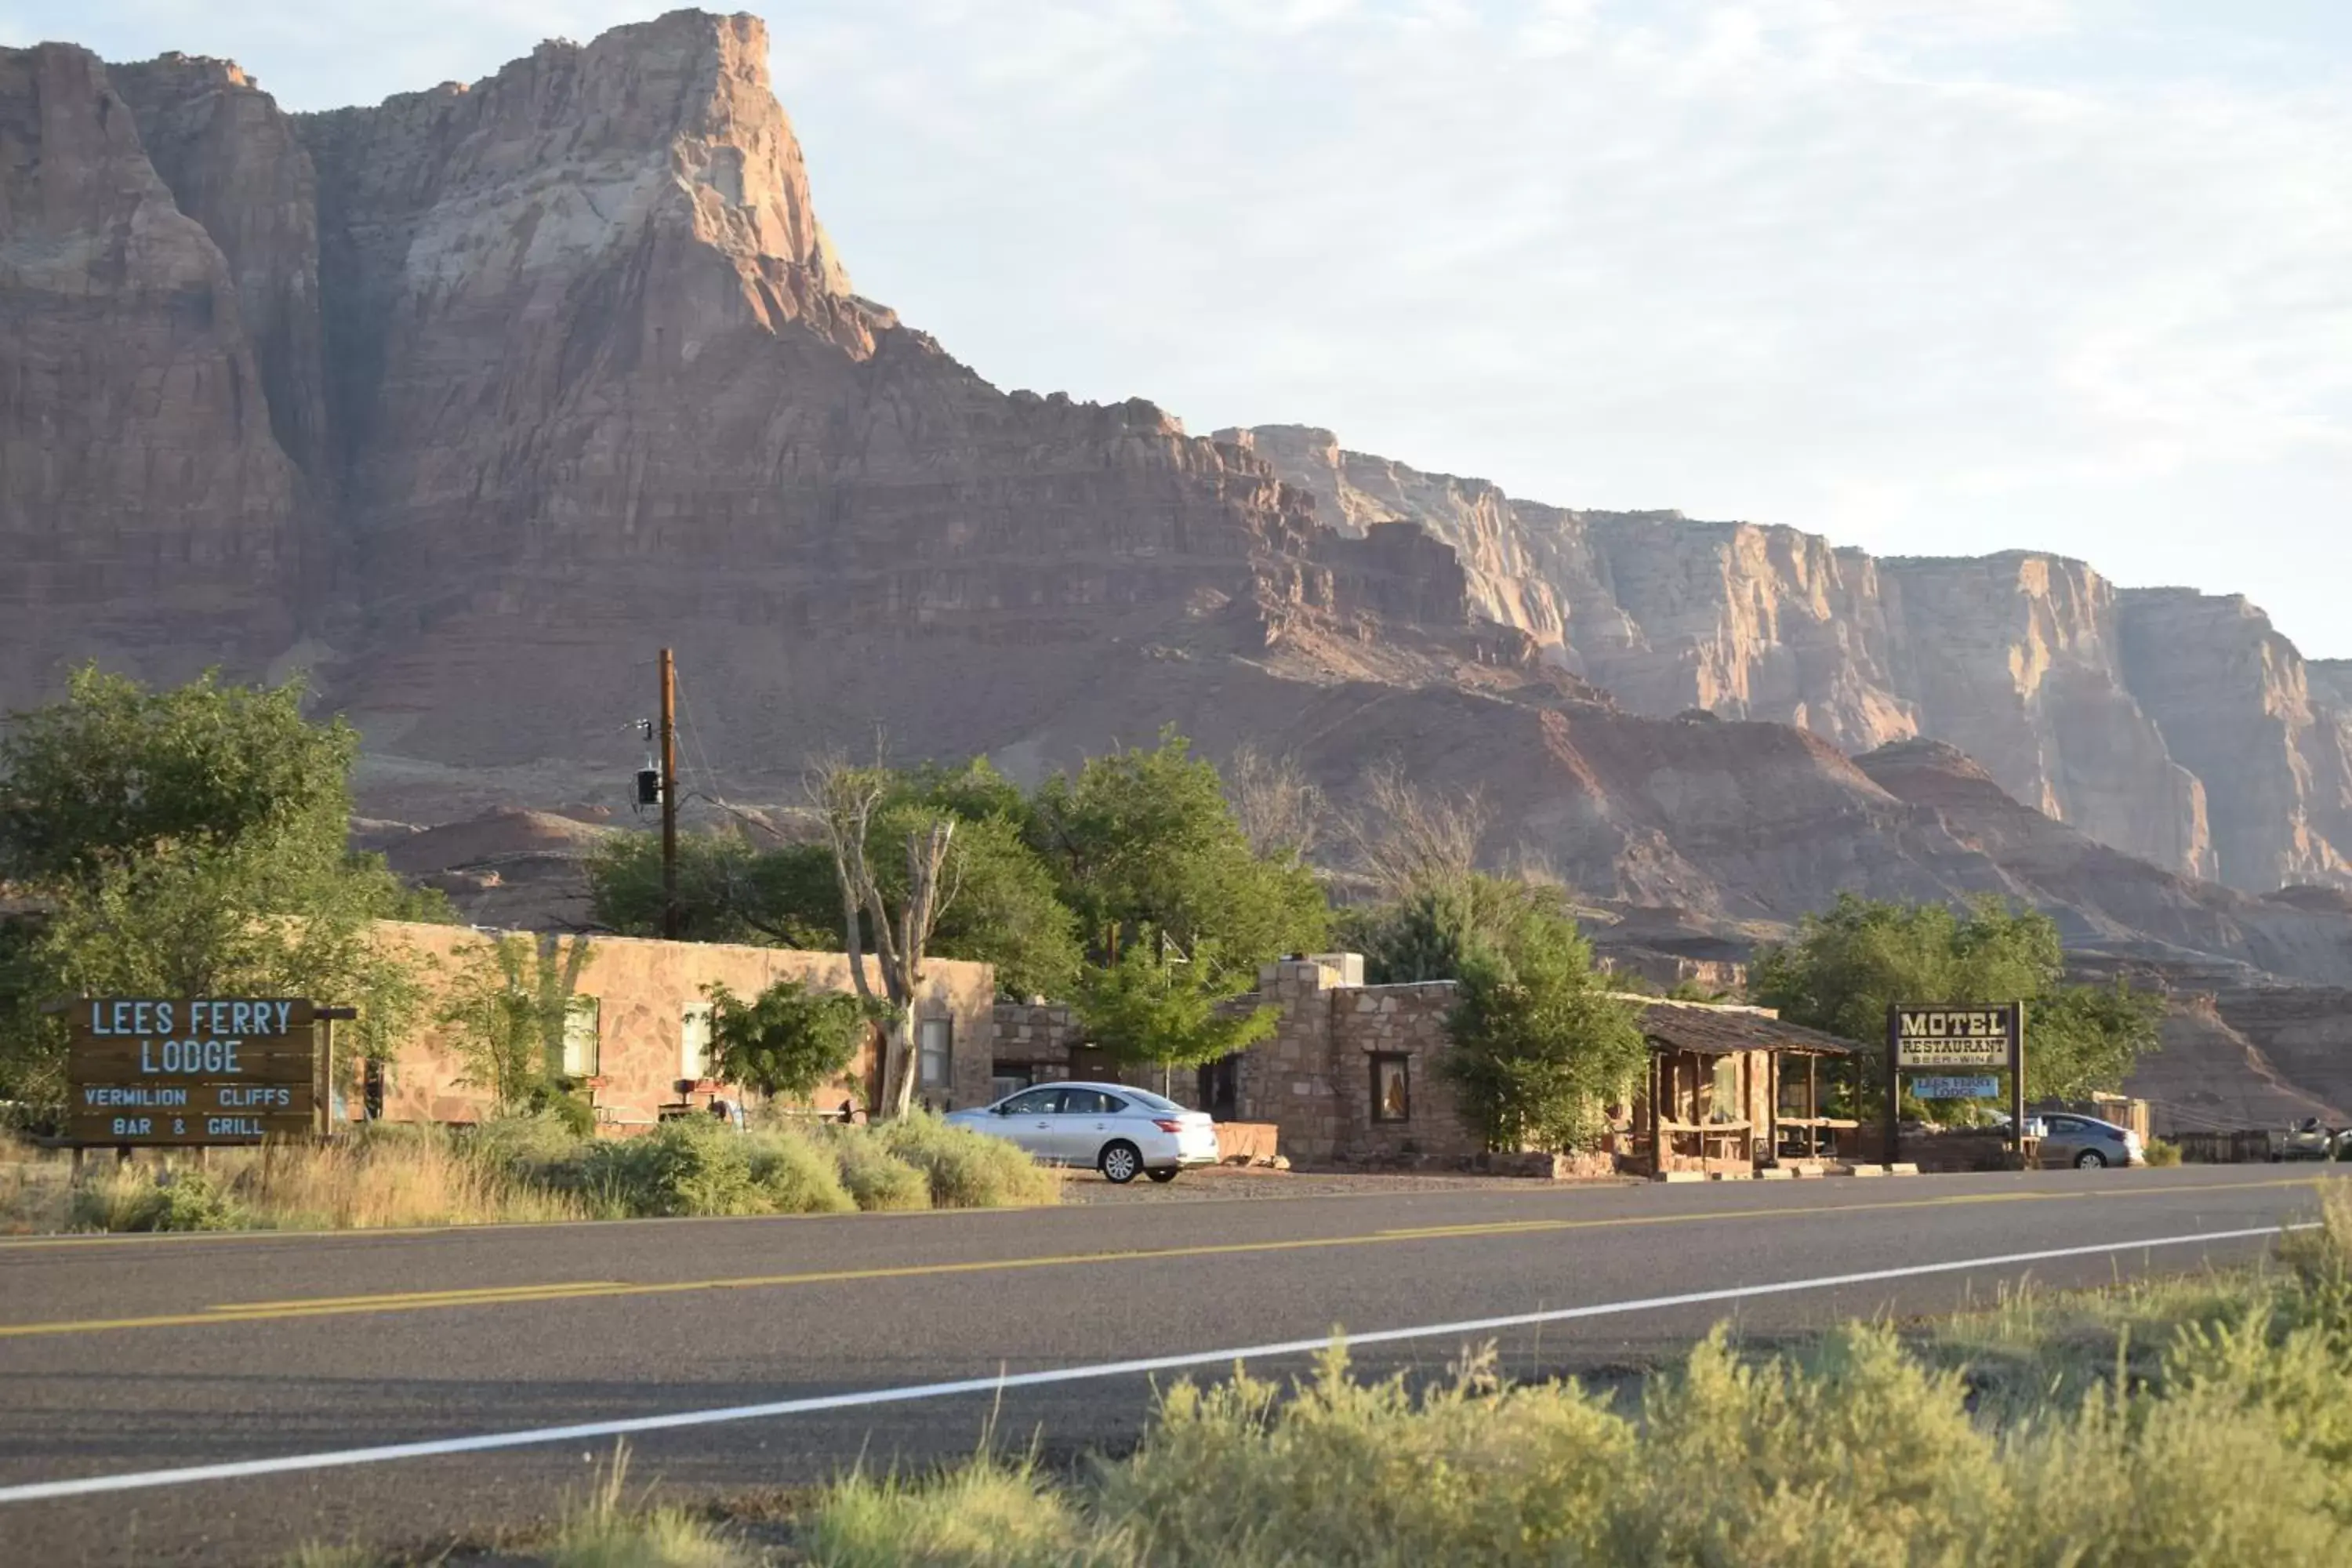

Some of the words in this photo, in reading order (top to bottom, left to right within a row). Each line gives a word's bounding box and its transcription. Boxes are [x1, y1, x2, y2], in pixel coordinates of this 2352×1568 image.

[93, 1002, 172, 1035] LEES
[191, 1002, 291, 1035] FERRY
[1901, 1012, 2005, 1035] MOTEL
[142, 1040, 243, 1073] LODGE
[1903, 1040, 2004, 1054] RESTAURANT
[85, 1089, 187, 1105] VERMILION
[220, 1089, 290, 1105] CLIFFS
[113, 1119, 151, 1134] BAR
[174, 1120, 185, 1134] &
[208, 1119, 265, 1134] GRILL
